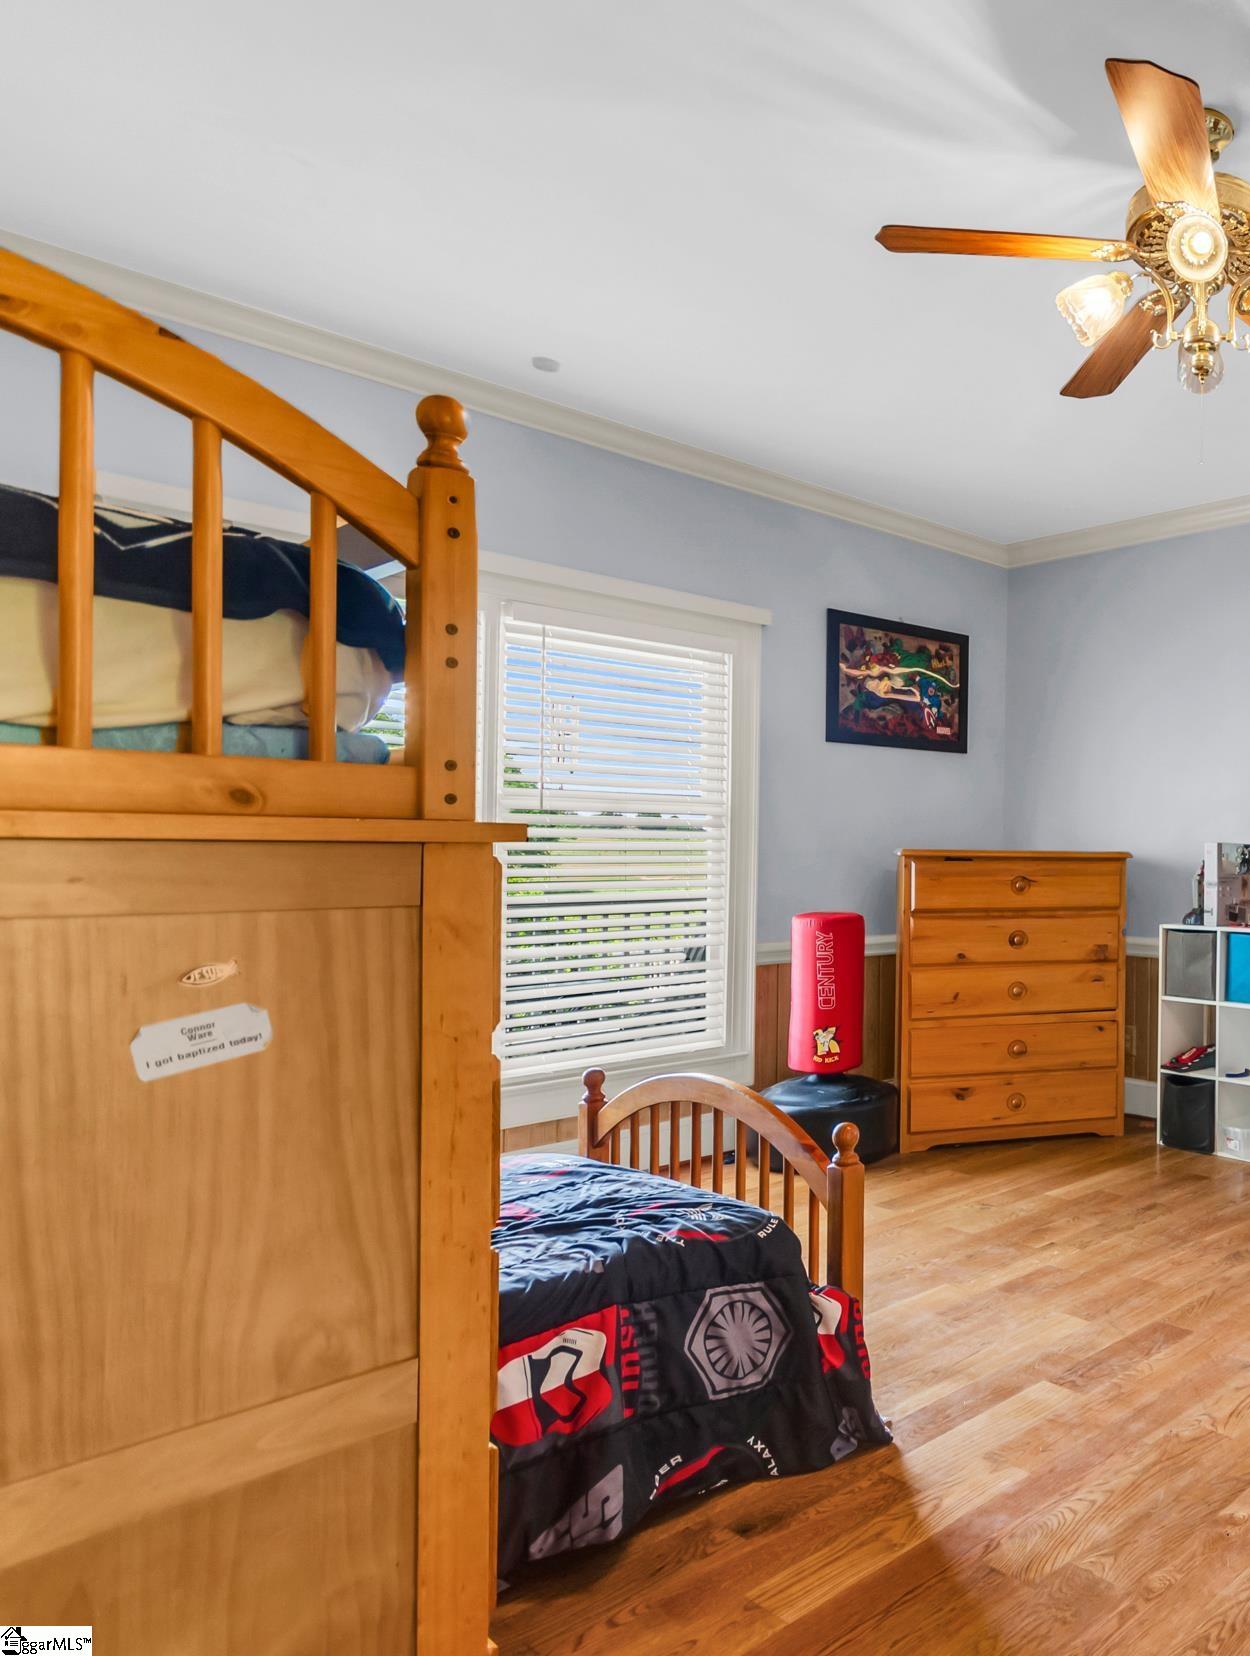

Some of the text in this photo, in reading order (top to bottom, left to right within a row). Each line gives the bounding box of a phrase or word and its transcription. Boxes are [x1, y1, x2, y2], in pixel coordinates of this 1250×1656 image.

[815, 930, 836, 1010] CENTURY
[181, 1022, 216, 1036] Connor
[187, 1030, 213, 1042] Ware
[155, 1056, 174, 1068] got
[177, 1043, 225, 1061] baptized
[229, 1032, 263, 1048] today!
[757, 1218, 779, 1239] RULE
[746, 1435, 779, 1476] ALAXY
